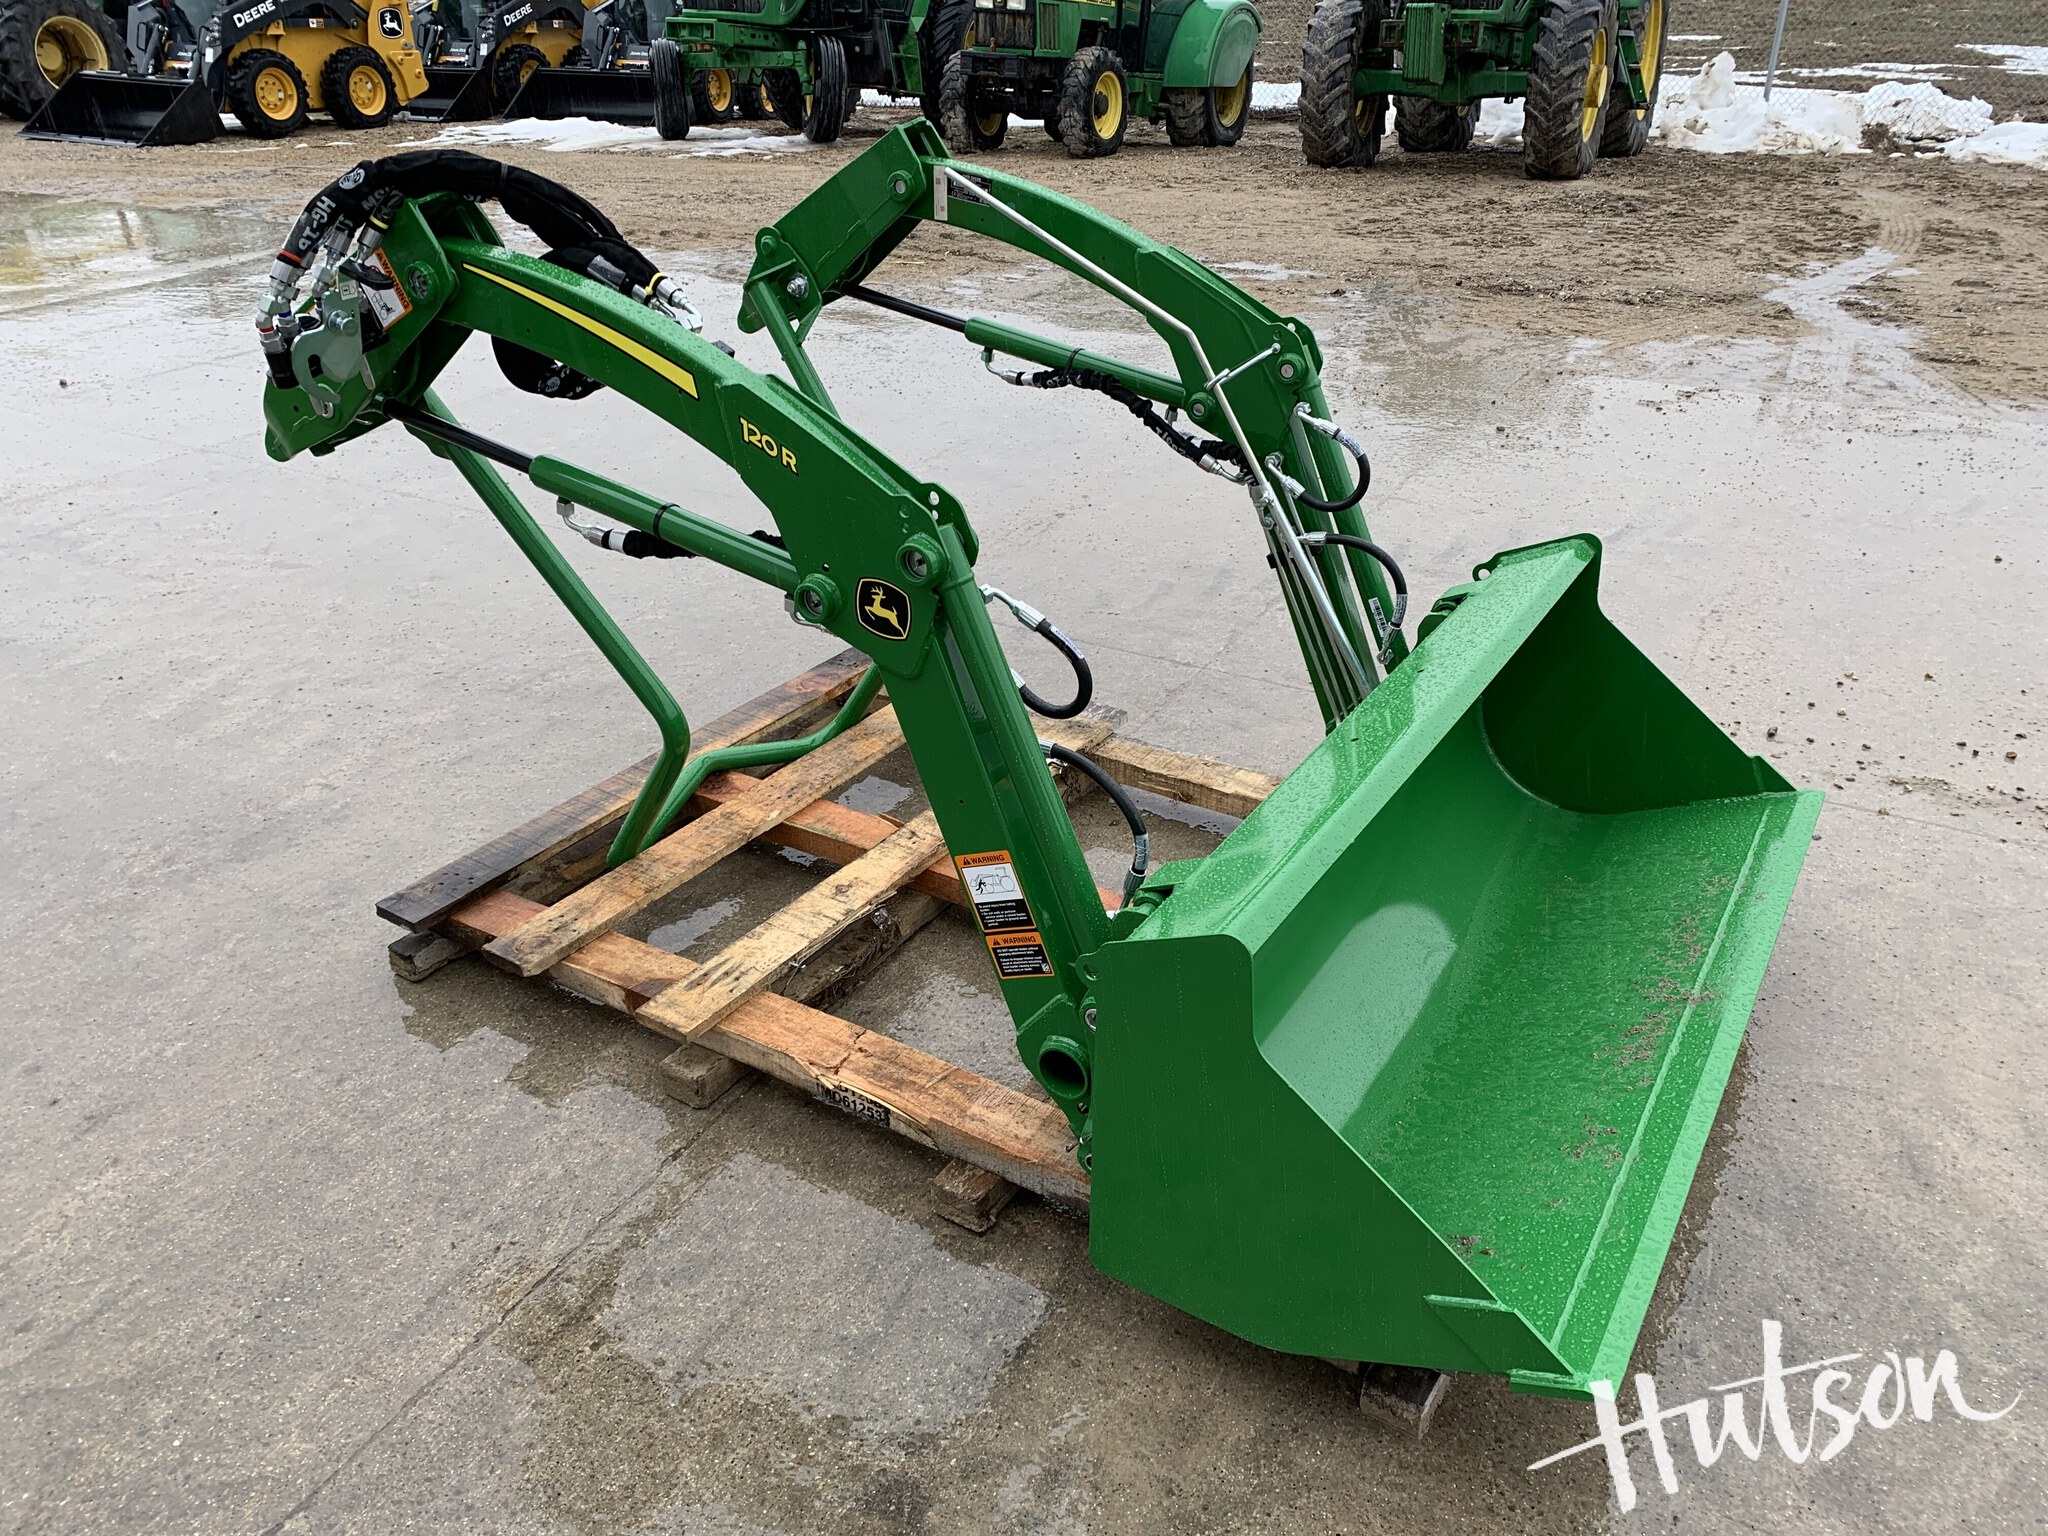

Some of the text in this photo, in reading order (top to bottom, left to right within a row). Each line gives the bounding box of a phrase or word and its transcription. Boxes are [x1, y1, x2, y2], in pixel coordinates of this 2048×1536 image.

[232, 0, 276, 28] DEERE
[503, 3, 533, 27] DEERE
[969, 854, 1005, 865] WARNING
[1001, 935, 1037, 945] WARNING
